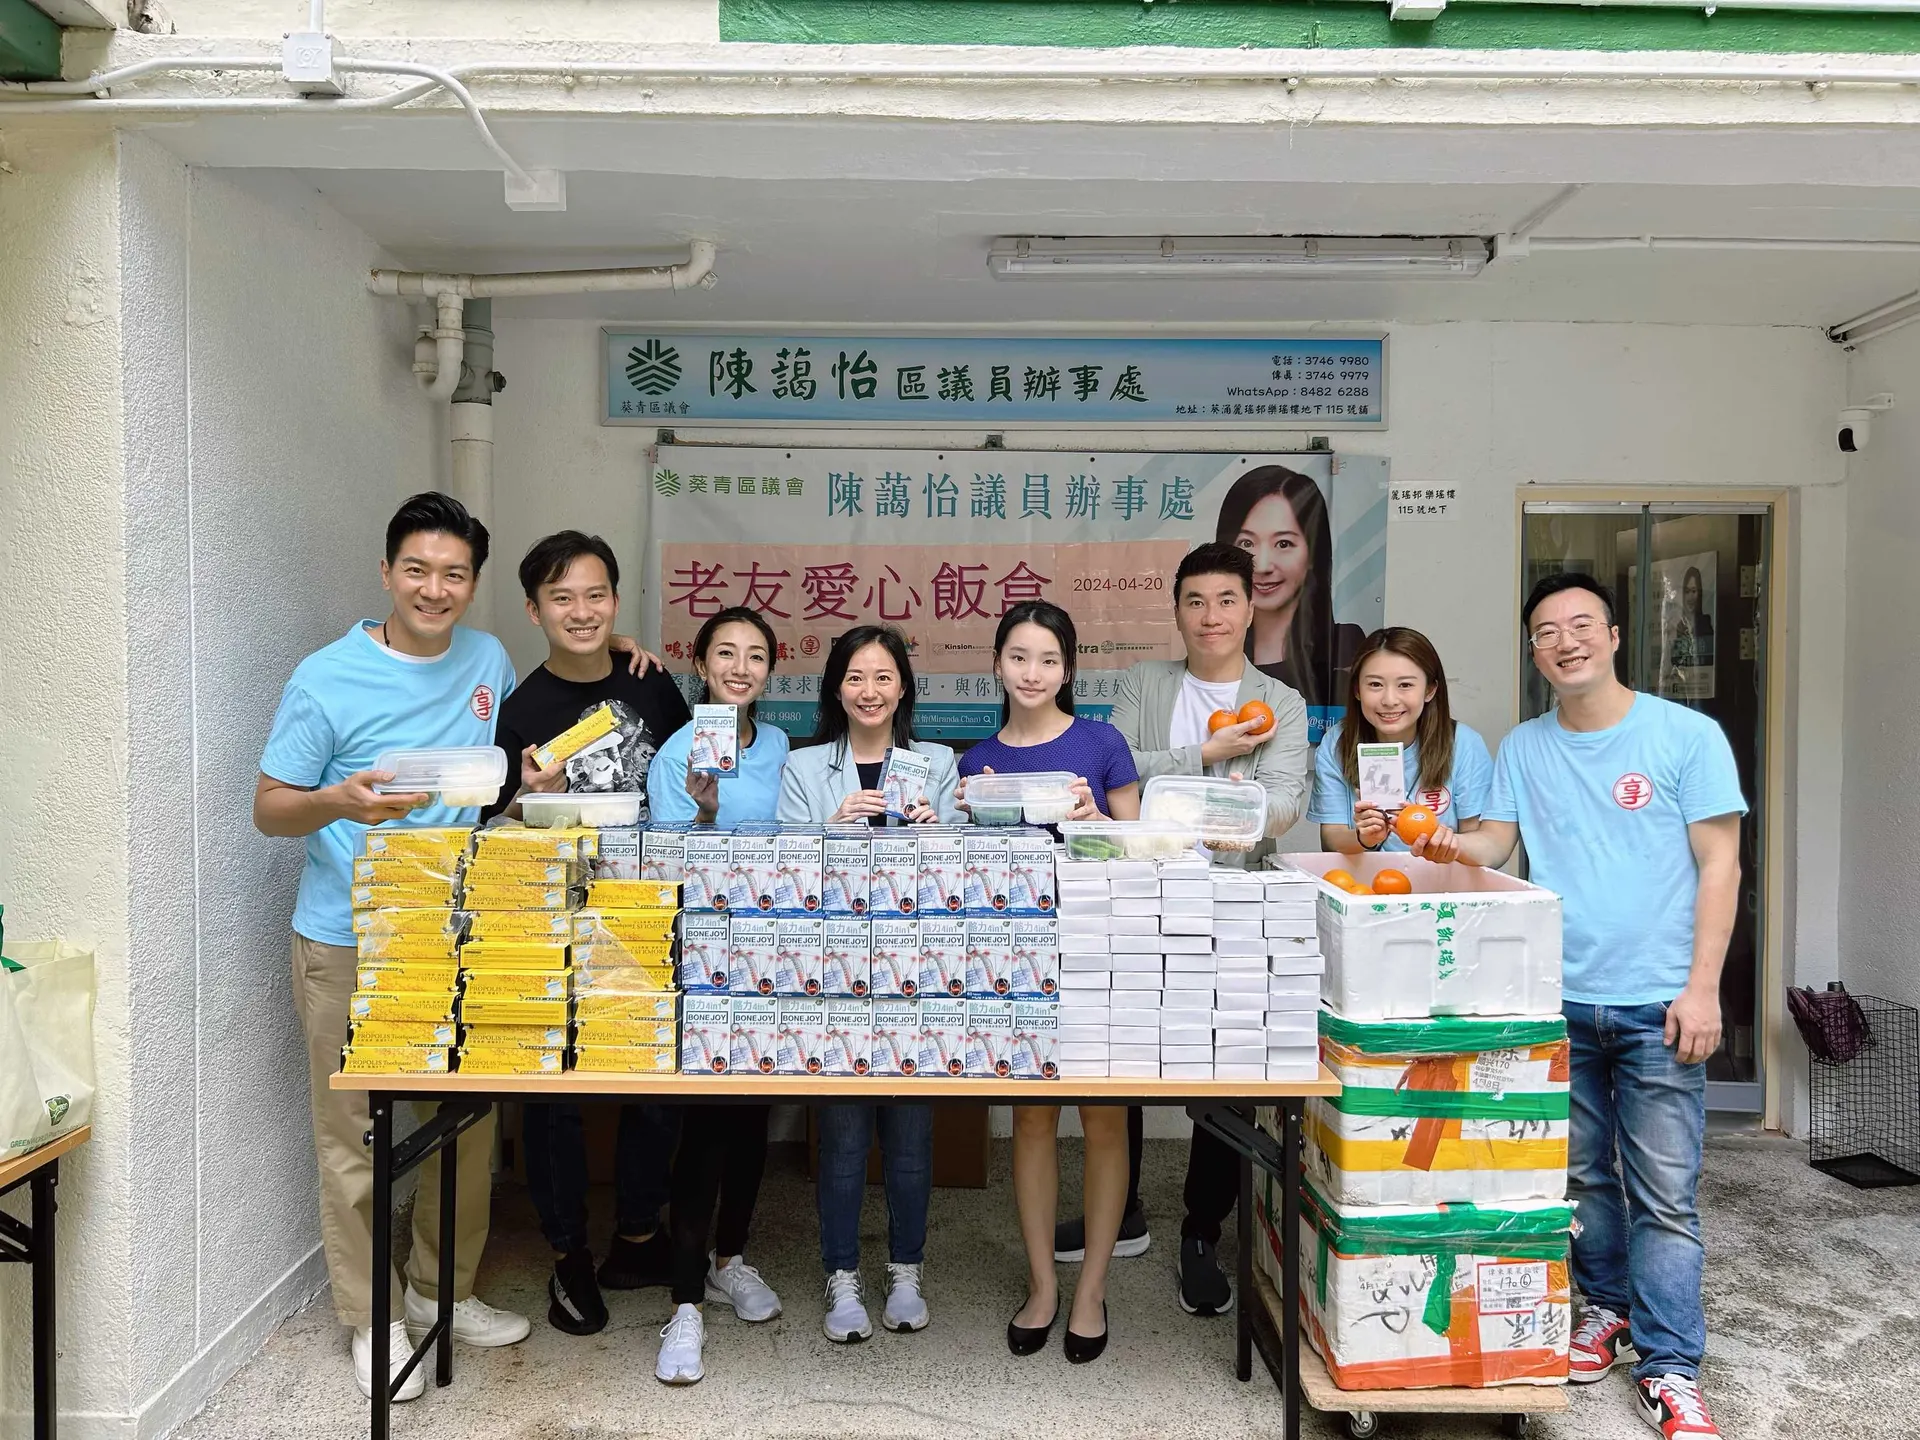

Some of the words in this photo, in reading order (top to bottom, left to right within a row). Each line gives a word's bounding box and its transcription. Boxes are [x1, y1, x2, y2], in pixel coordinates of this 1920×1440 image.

[1339, 356, 1369, 366] 9980
[1340, 372, 1369, 380] 9979
[1338, 388, 1369, 396] 6288
[620, 400, 690, 414] 葵青區議會
[688, 474, 804, 497] 葵青區議會
[828, 471, 1196, 521] 陳藹怡議員辦事處
[1073, 577, 1163, 592] 2024-04-20
